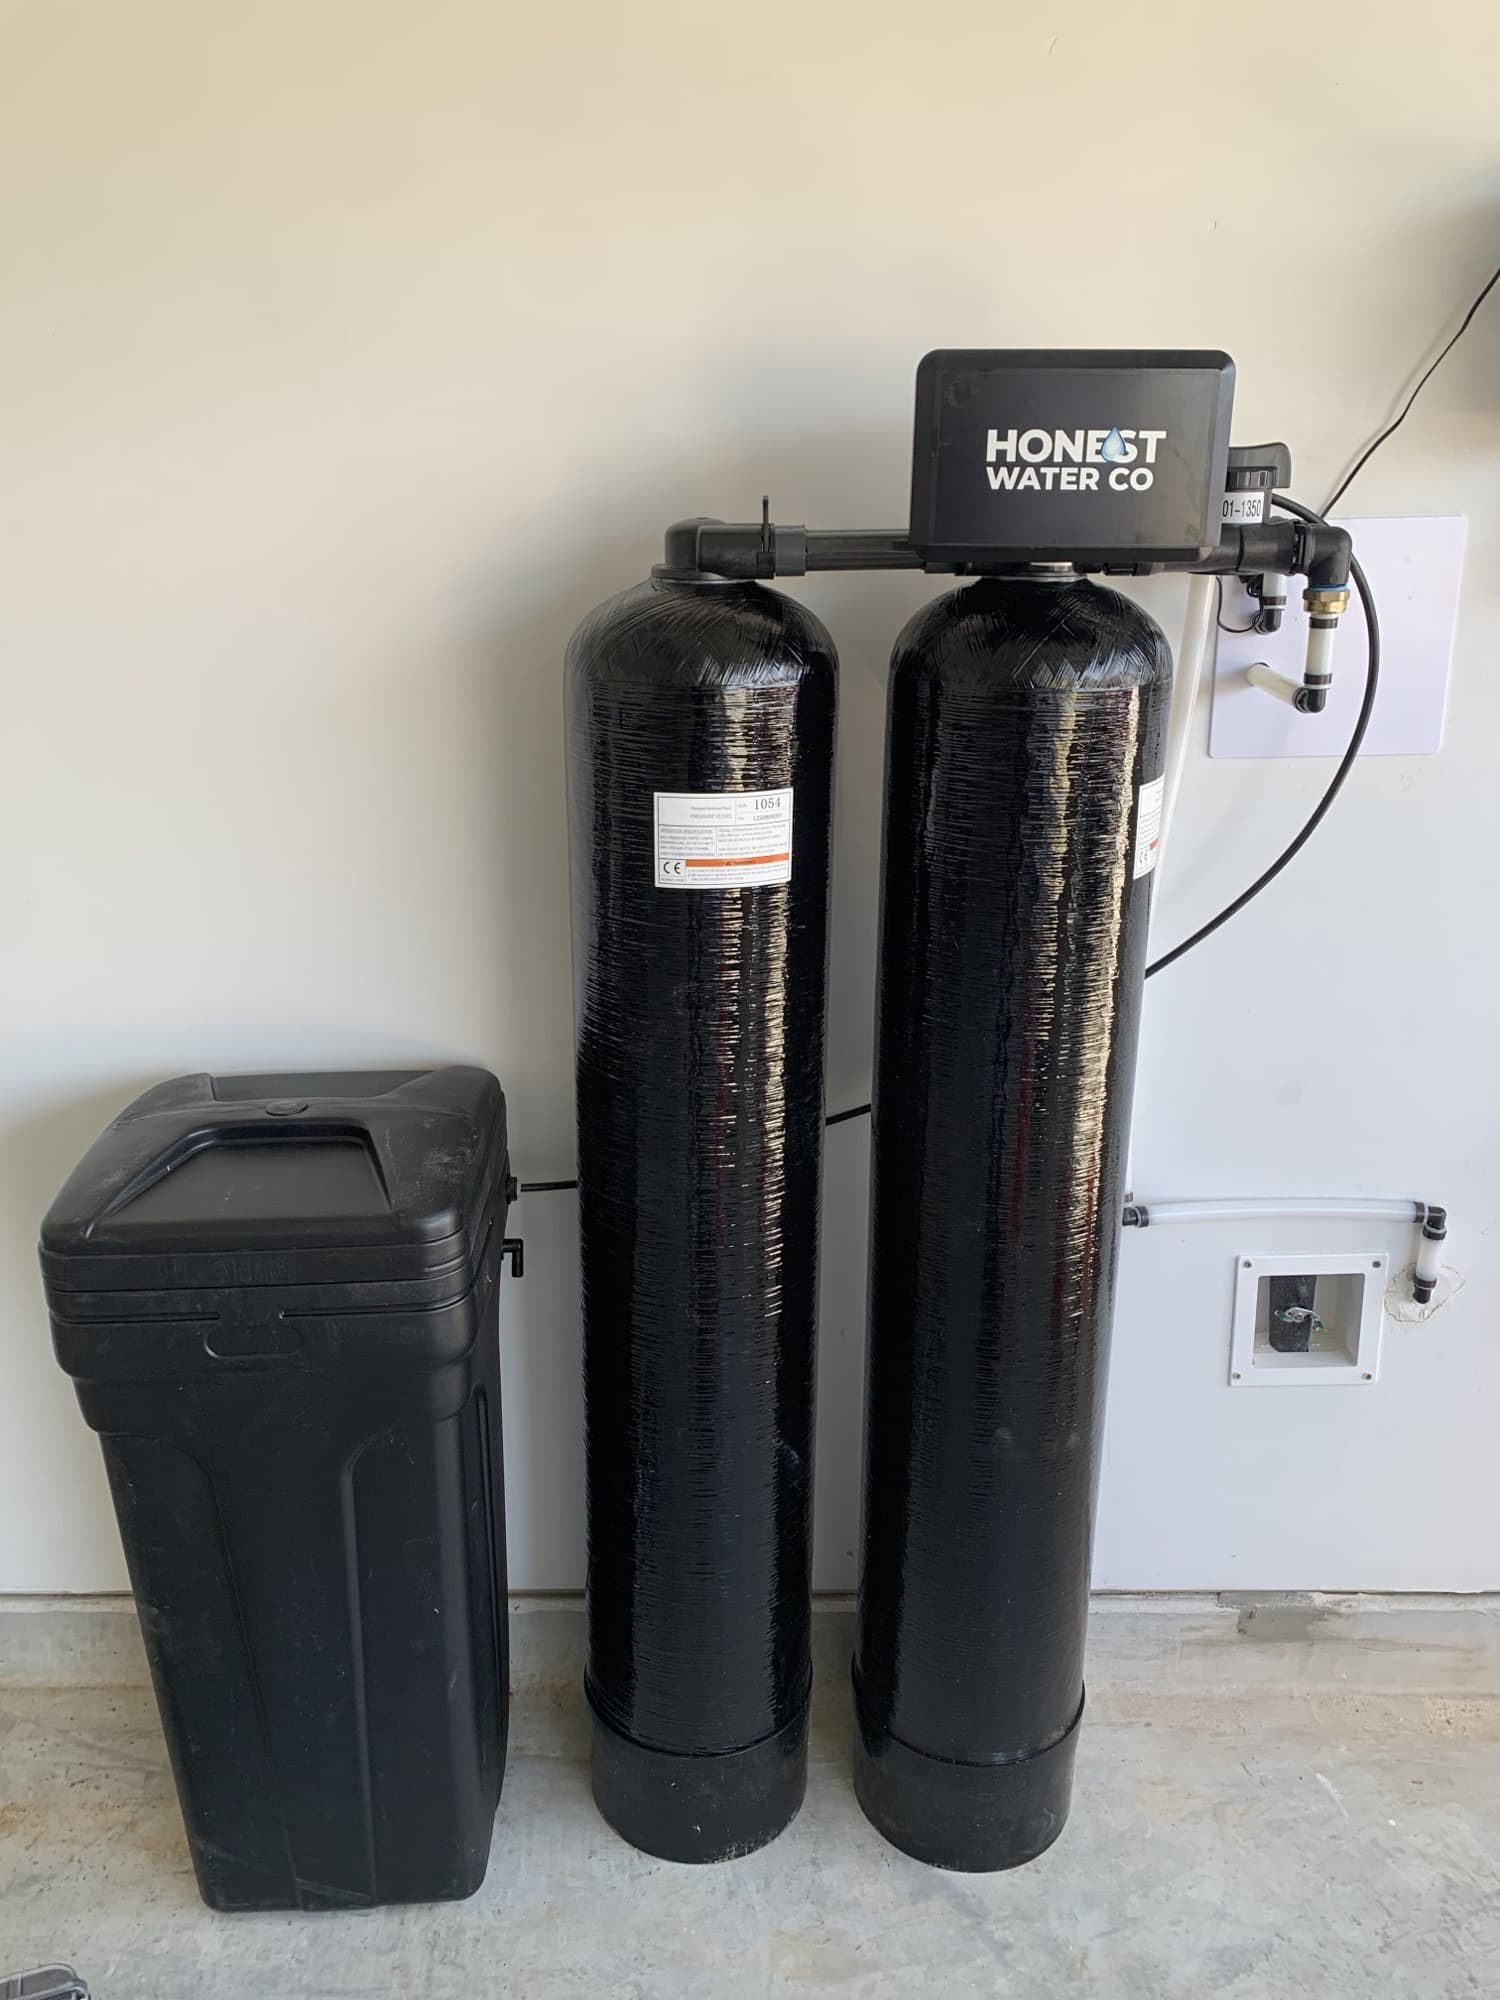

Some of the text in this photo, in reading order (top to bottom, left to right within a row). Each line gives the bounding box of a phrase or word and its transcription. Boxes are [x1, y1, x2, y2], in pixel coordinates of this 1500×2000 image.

[986, 428, 1167, 464] HONEST
[986, 467, 1154, 492] WATER CO
[1222, 499, 1262, 518] 01-1350
[754, 797, 781, 810] 1054
